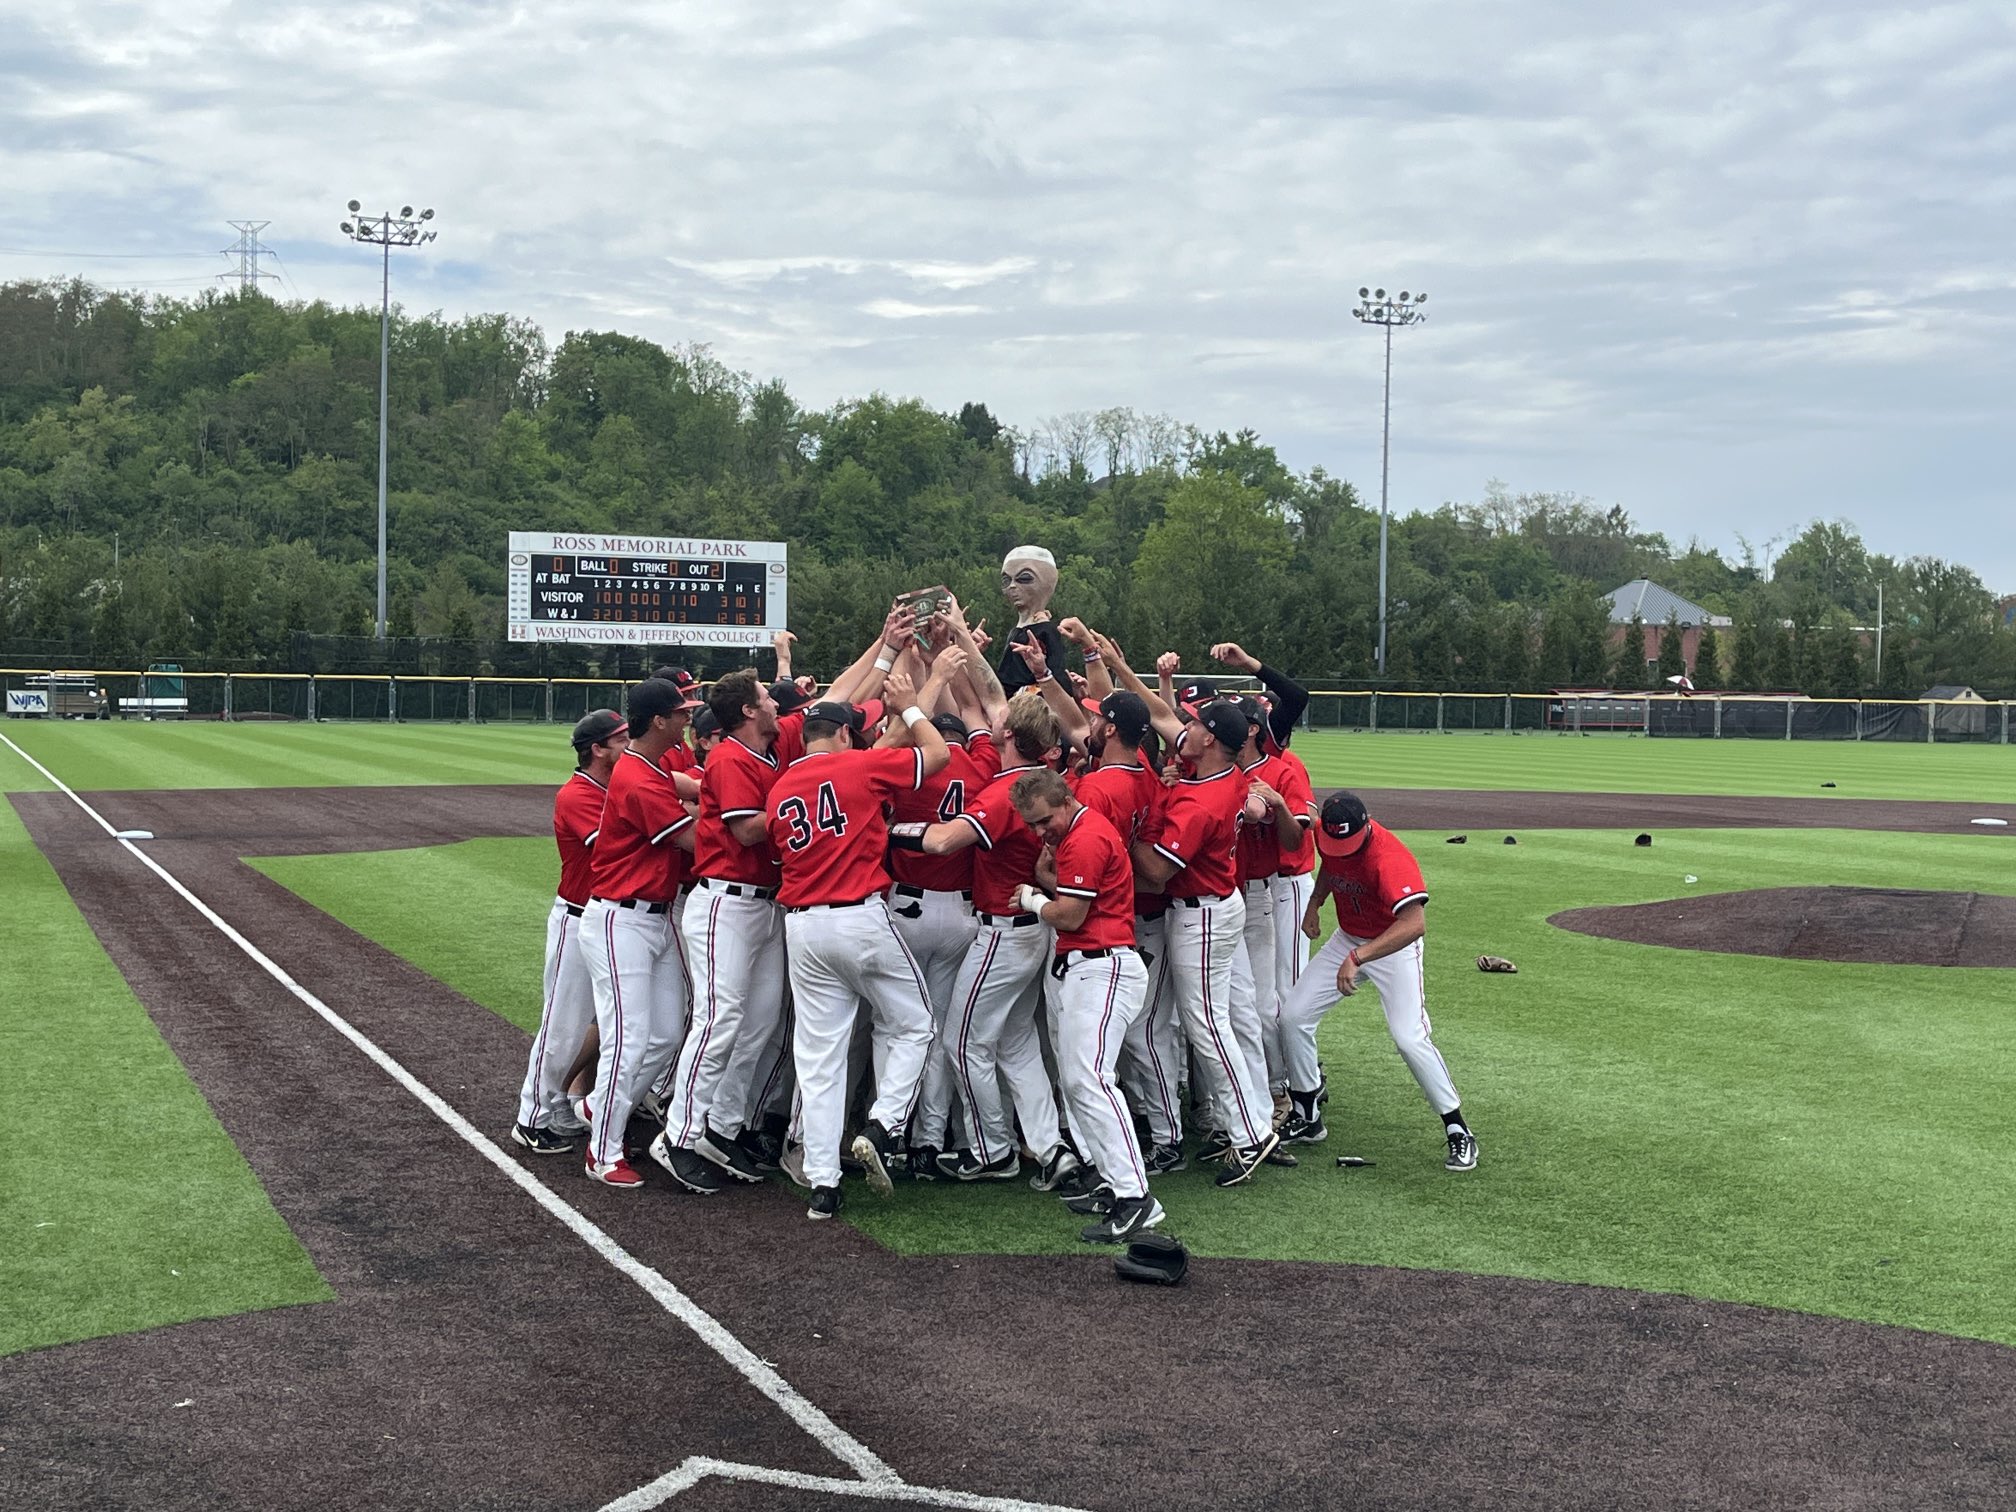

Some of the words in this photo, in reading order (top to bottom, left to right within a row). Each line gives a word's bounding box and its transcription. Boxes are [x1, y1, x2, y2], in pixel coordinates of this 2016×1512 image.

[552, 536, 596, 551] ROSS
[601, 538, 697, 555] MEMORIAL
[701, 542, 748, 557] PARK
[553, 557, 563, 572] 0
[580, 560, 608, 572] BALL
[610, 559, 618, 574] 0
[632, 562, 668, 574] STRIKE
[669, 561, 678, 577] 0
[689, 564, 710, 575] OUT
[711, 563, 720, 578] 2
[535, 573, 549, 584] AT
[552, 573, 571, 584] BAT
[594, 579, 599, 588] 1
[605, 580, 611, 588] 2
[616, 580, 622, 589] 3
[631, 580, 638, 589] 4
[643, 581, 649, 589] 5
[653, 581, 660, 590] 6
[669, 582, 675, 591] 7
[680, 582, 686, 591] 8
[691, 582, 697, 591] 9
[700, 583, 710, 592] 10
[717, 583, 724, 592] R
[736, 584, 743, 593] H
[754, 584, 761, 593] E
[540, 591, 584, 603] VISITOR
[603, 592, 611, 604] 0
[615, 592, 622, 605] 0
[630, 592, 638, 605] 0
[642, 593, 649, 605] 0
[652, 593, 660, 606] 0
[690, 594, 697, 607] 0
[547, 608, 558, 619] W
[615, 609, 622, 621] 0
[652, 610, 660, 622] 0
[668, 610, 675, 622] 0
[535, 626, 625, 640] WASHINGTON
[628, 630, 636, 640] &
[640, 630, 706, 642] JEFFERSON
[708, 630, 761, 644] COLLEGE
[9, 693, 46, 710] WJPA
[937, 779, 965, 823] 4
[777, 780, 848, 852] 34
